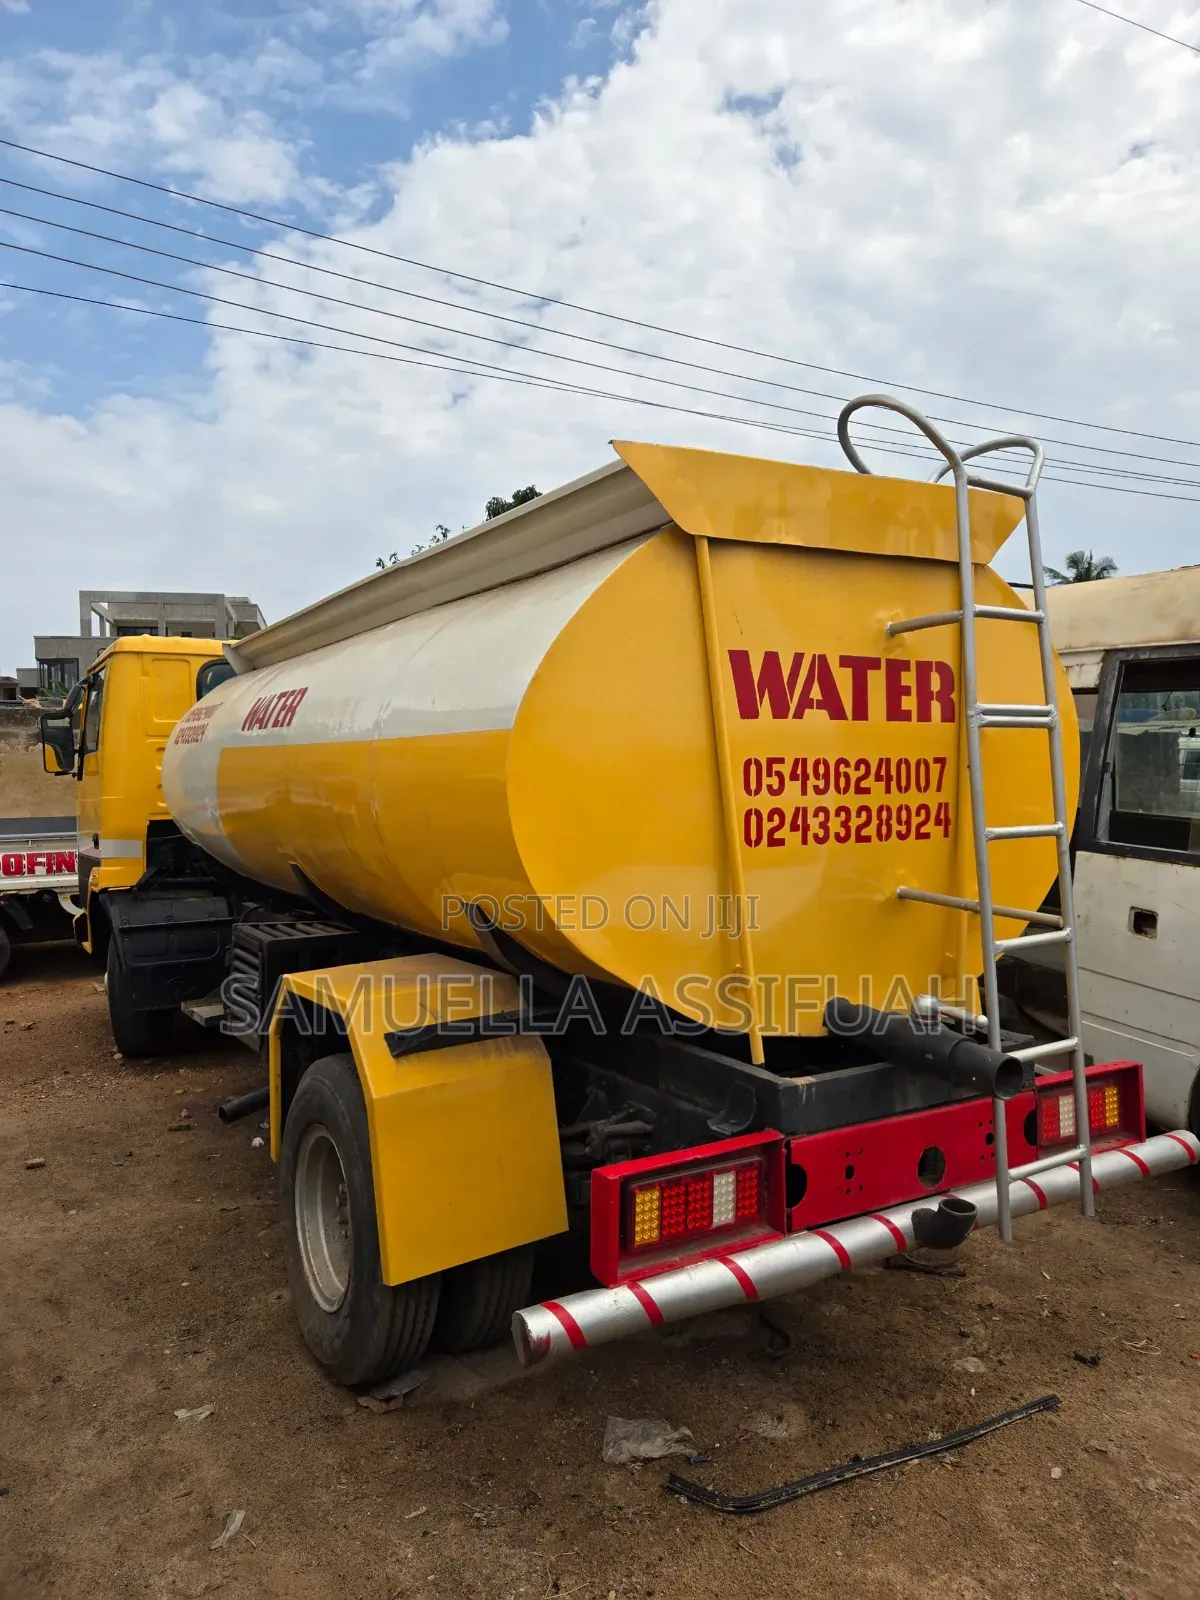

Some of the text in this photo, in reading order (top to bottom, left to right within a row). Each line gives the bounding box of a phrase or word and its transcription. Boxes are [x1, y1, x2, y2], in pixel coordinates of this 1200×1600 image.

[727, 649, 956, 723] WATER
[241, 687, 309, 732] WATER
[743, 757, 948, 797] 0549624007
[743, 801, 952, 848] 0243328924
[0, 850, 77, 877] OFIN
